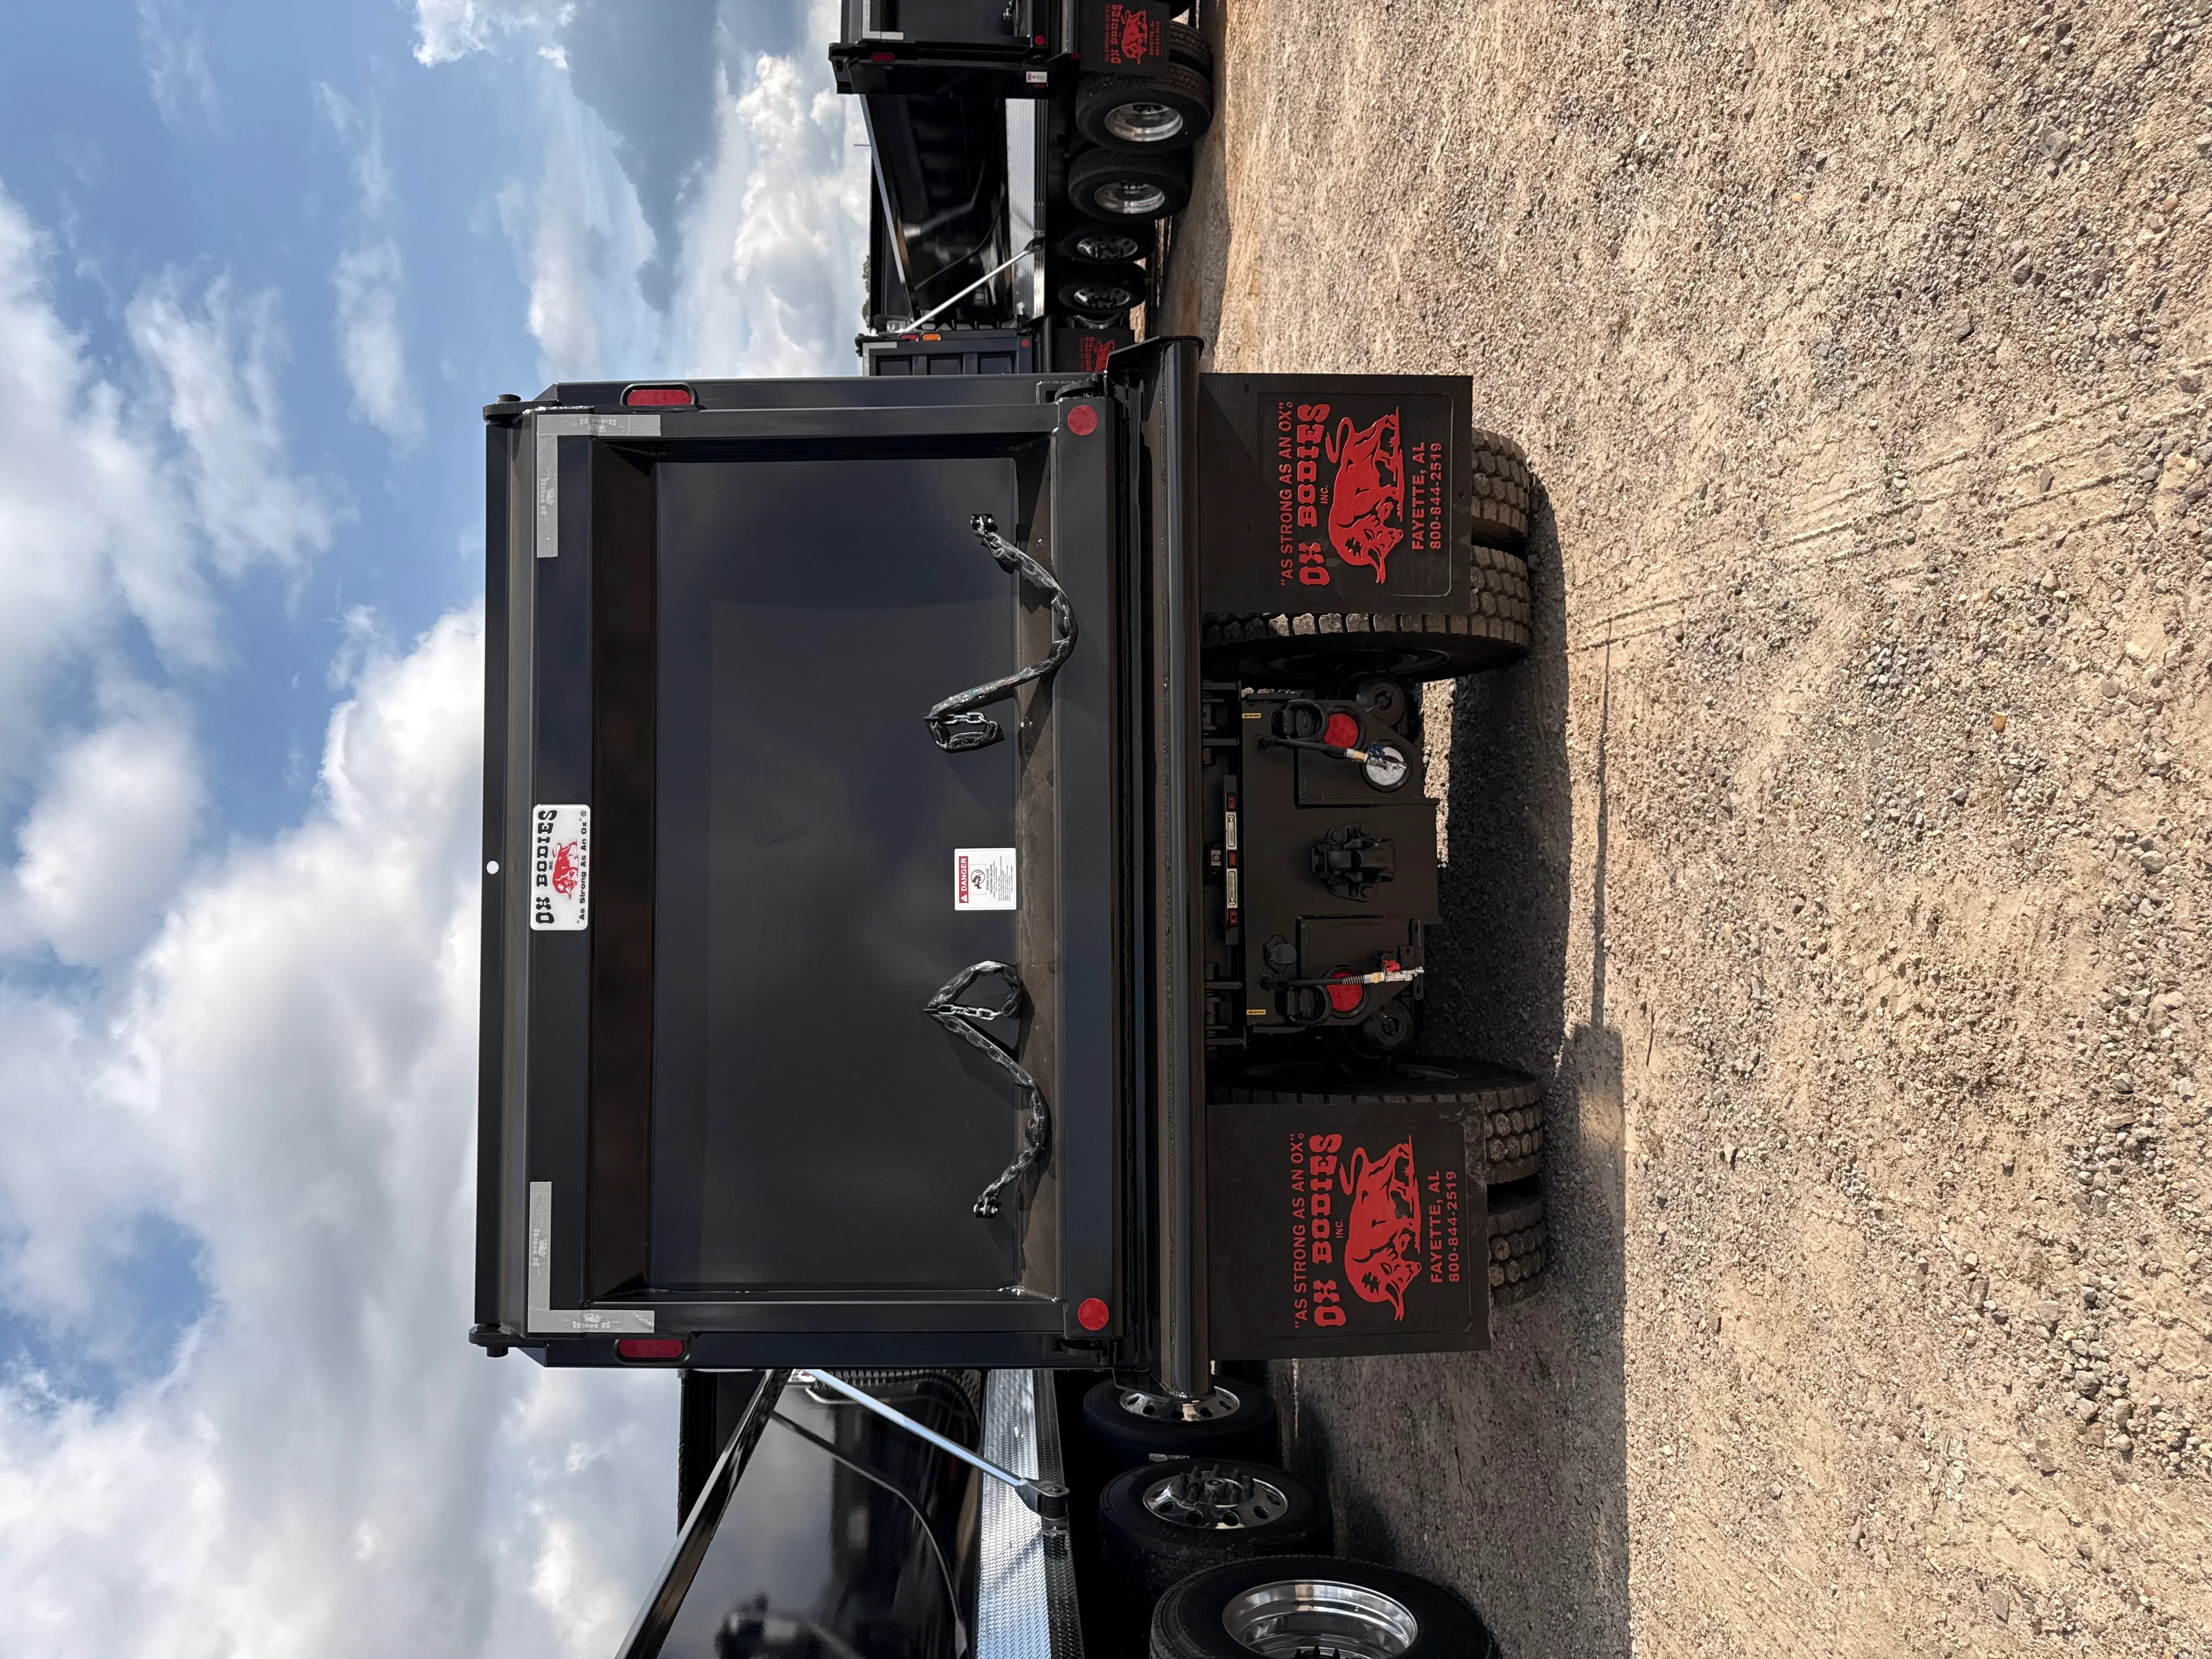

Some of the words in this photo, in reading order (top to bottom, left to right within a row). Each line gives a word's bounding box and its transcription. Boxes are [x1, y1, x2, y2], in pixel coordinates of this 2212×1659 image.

[1111, 4, 1122, 44] BODIES
[1110, 49, 1121, 64] OX
[1279, 437, 1292, 459] AN
[1412, 442, 1425, 464] AL
[1279, 463, 1293, 484] AS
[1297, 403, 1331, 528] BODIES
[1321, 485, 1329, 504] INC.
[1430, 443, 1442, 550] 800-844-2519
[1279, 489, 1293, 554] STRONG
[1412, 470, 1427, 550] FAYETTE,
[1280, 559, 1294, 586] "AS
[1298, 541, 1331, 586] OX
[536, 810, 557, 887] BODIES
[581, 838, 586, 851] An
[580, 855, 586, 867] As
[535, 896, 555, 924] OX
[577, 908, 585, 923] "As
[1291, 1169, 1304, 1192] AN
[1428, 1170, 1440, 1193] AL
[1292, 1197, 1305, 1219] AS
[1309, 1133, 1343, 1263] BODIES
[1335, 1218, 1344, 1239] INC.
[1446, 1171, 1460, 1282] 800-844-2519
[1429, 1199, 1443, 1283] FAYETTE,
[533, 1257, 540, 1266] OX
[1293, 1224, 1307, 1294] STRONG
[1294, 1298, 1308, 1328] "AS
[1312, 1279, 1346, 1327] OX
